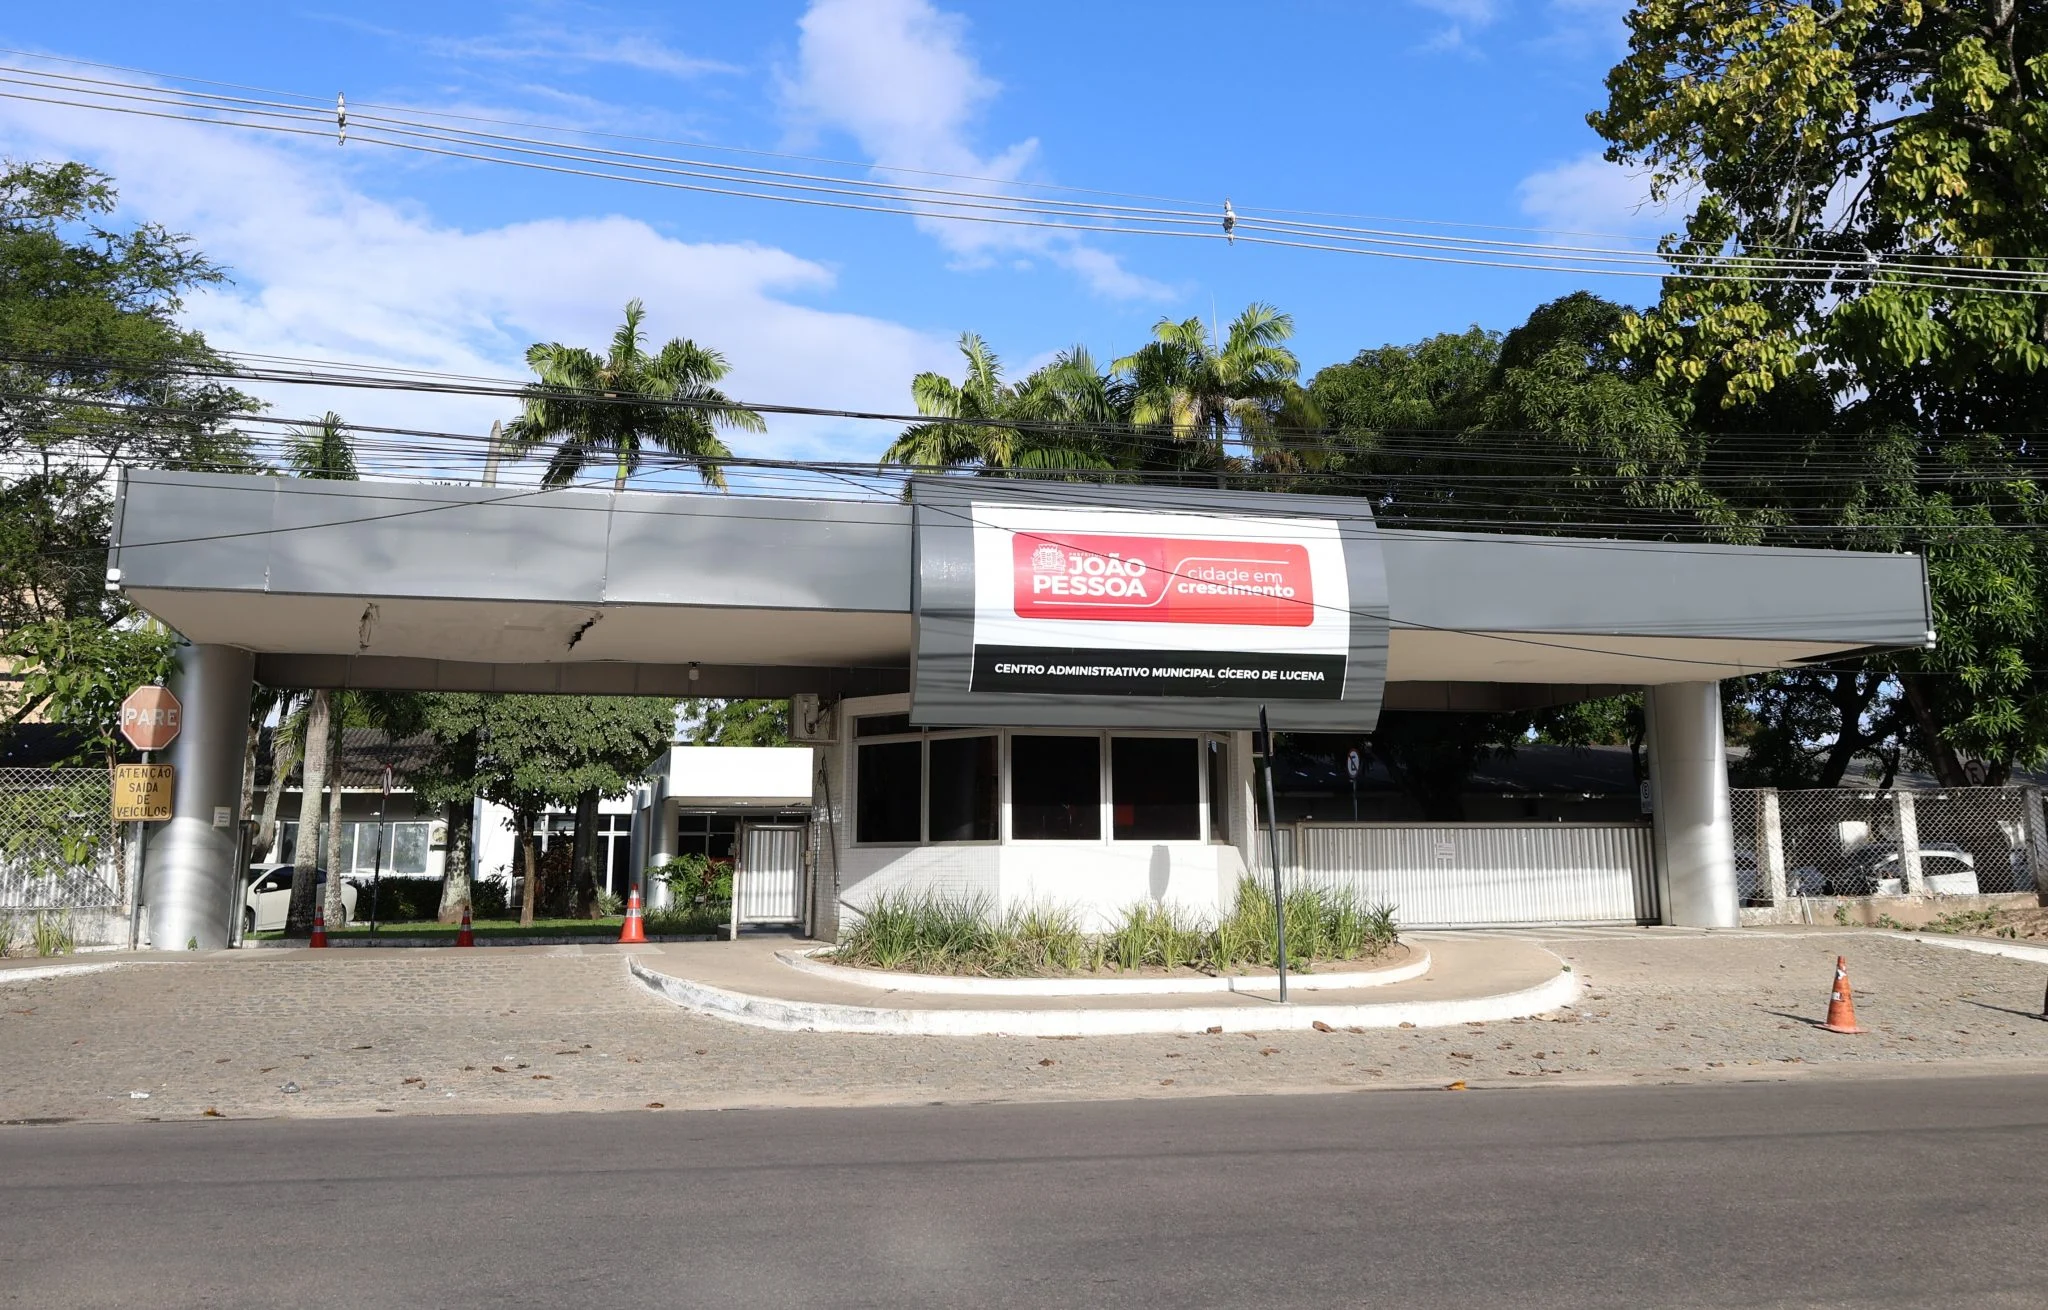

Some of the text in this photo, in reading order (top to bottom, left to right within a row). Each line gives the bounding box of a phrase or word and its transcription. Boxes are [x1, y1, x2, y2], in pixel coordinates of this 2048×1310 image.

[1068, 552, 1147, 578] JOÃO
[1187, 566, 1283, 583] cidade em
[1033, 575, 1148, 598] PESSOA
[1177, 581, 1295, 598] crescimento
[994, 663, 1325, 681] CENTRO ADMINISTRATIVO MUNICIPAL CÍCERO DE LUCENA
[125, 708, 178, 727] PARE
[136, 794, 151, 805] DE
[116, 804, 168, 818] VEÍCULOS
